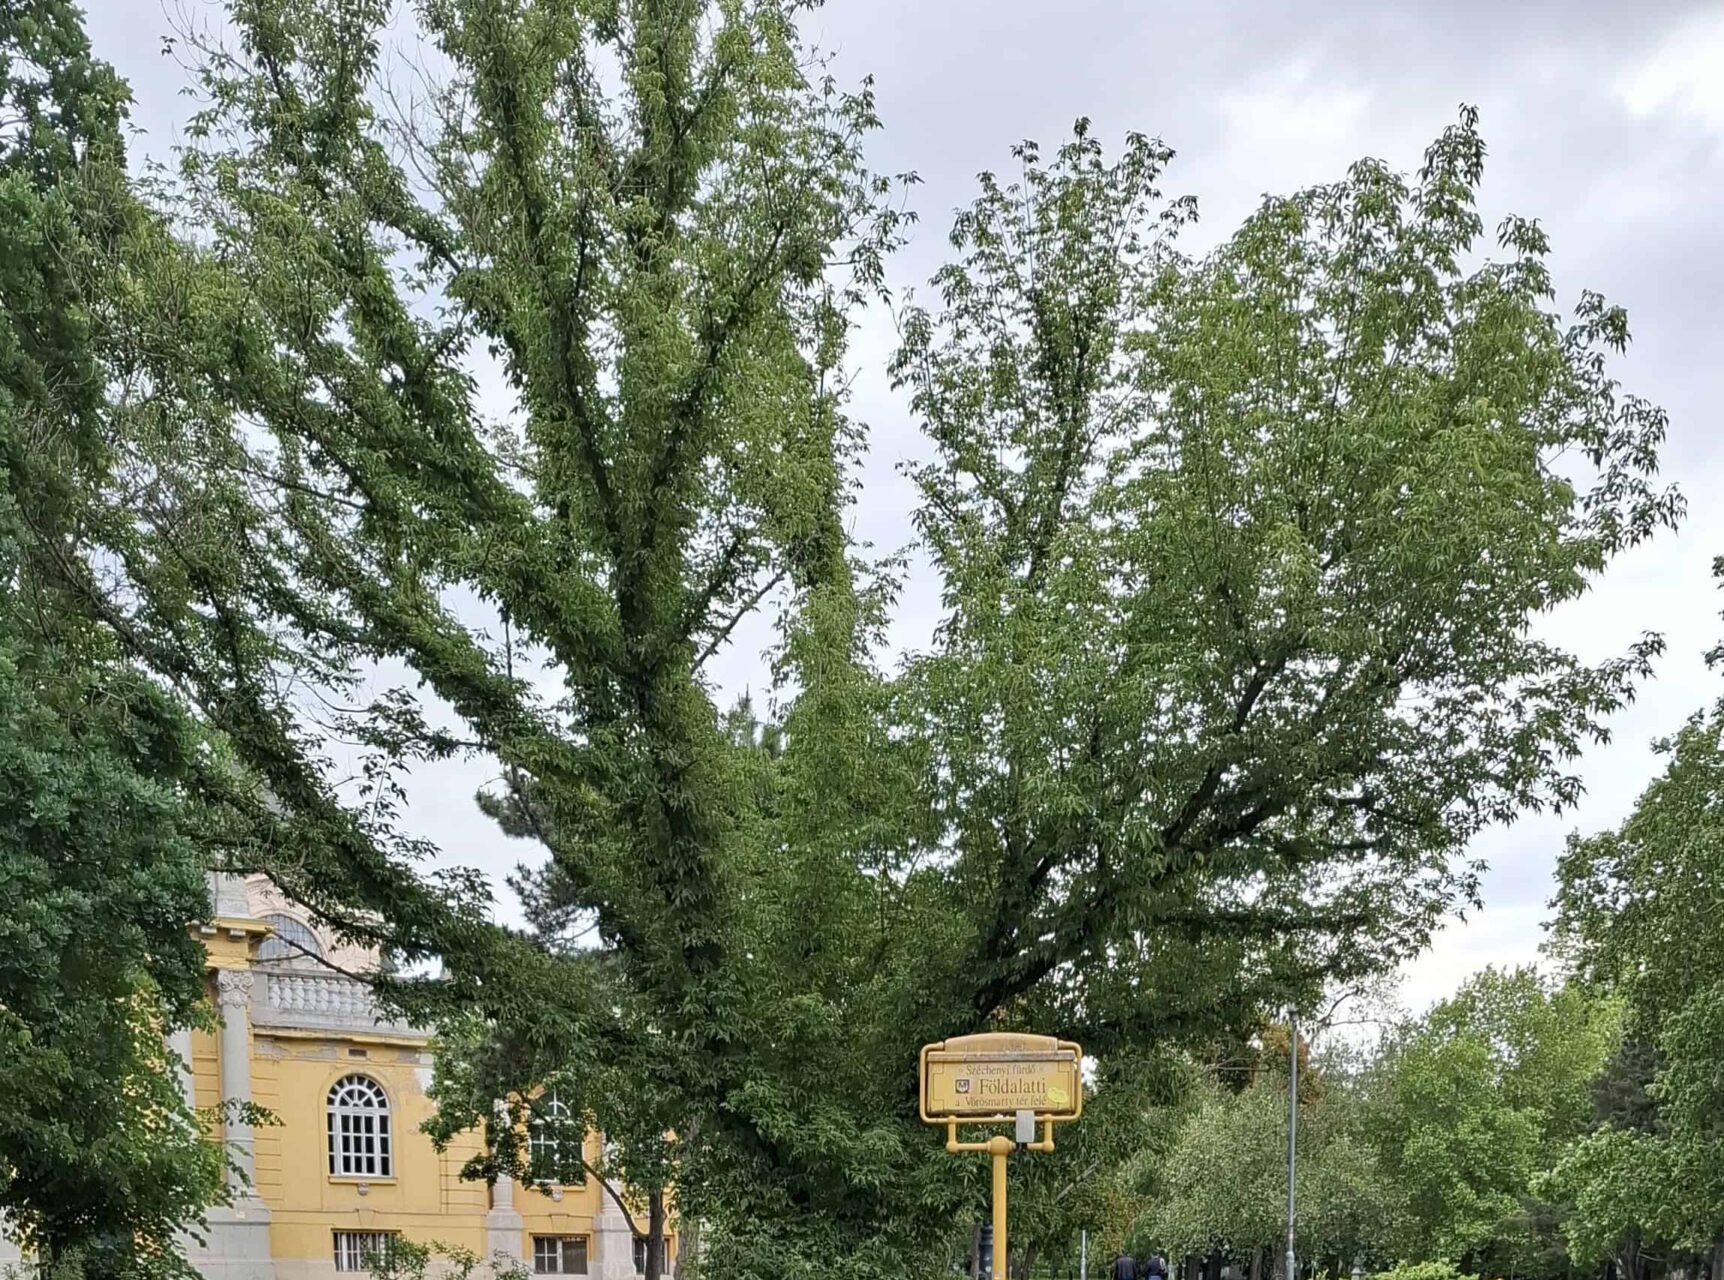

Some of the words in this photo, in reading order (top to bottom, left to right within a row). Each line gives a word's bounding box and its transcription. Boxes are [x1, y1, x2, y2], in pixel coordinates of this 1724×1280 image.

[966, 1065, 1010, 1076] Széchenyi
[979, 1078, 1046, 1094] Földalatti
[965, 1096, 1013, 1108] Vörösmarty
[1016, 1096, 1028, 1106] tér
[1030, 1096, 1046, 1106] felé
